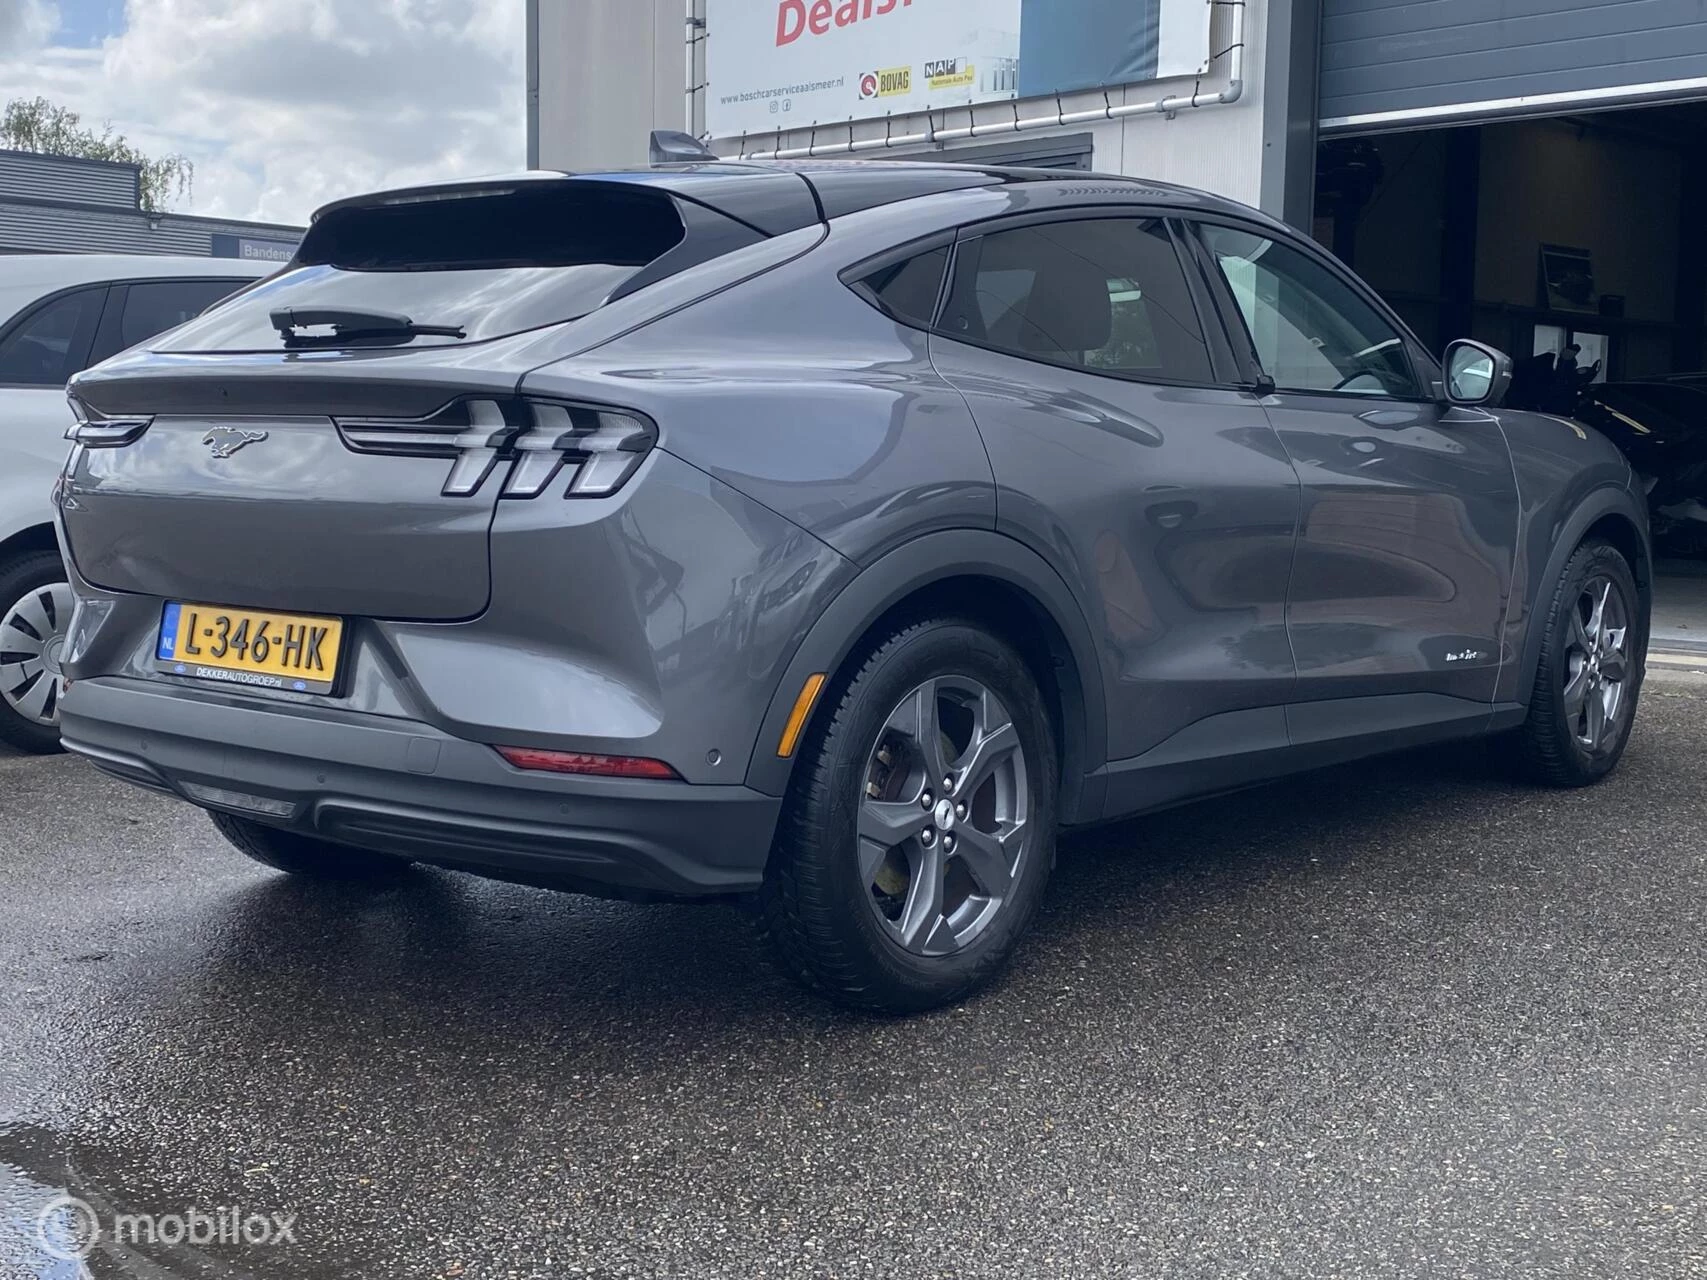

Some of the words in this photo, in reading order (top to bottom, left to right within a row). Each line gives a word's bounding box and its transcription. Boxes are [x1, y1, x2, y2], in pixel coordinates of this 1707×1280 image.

[776, 0, 912, 47] Dea
[925, 58, 955, 77] NAP
[720, 76, 844, 104] www.boschcarserviceaalsmeer.nl
[880, 71, 909, 92] BOVAG
[244, 245, 295, 260] Bandens
[162, 637, 174, 650] NL
[185, 613, 328, 671] L-346-HK
[196, 667, 282, 687] DEKKERAUTOGROEP.nl
